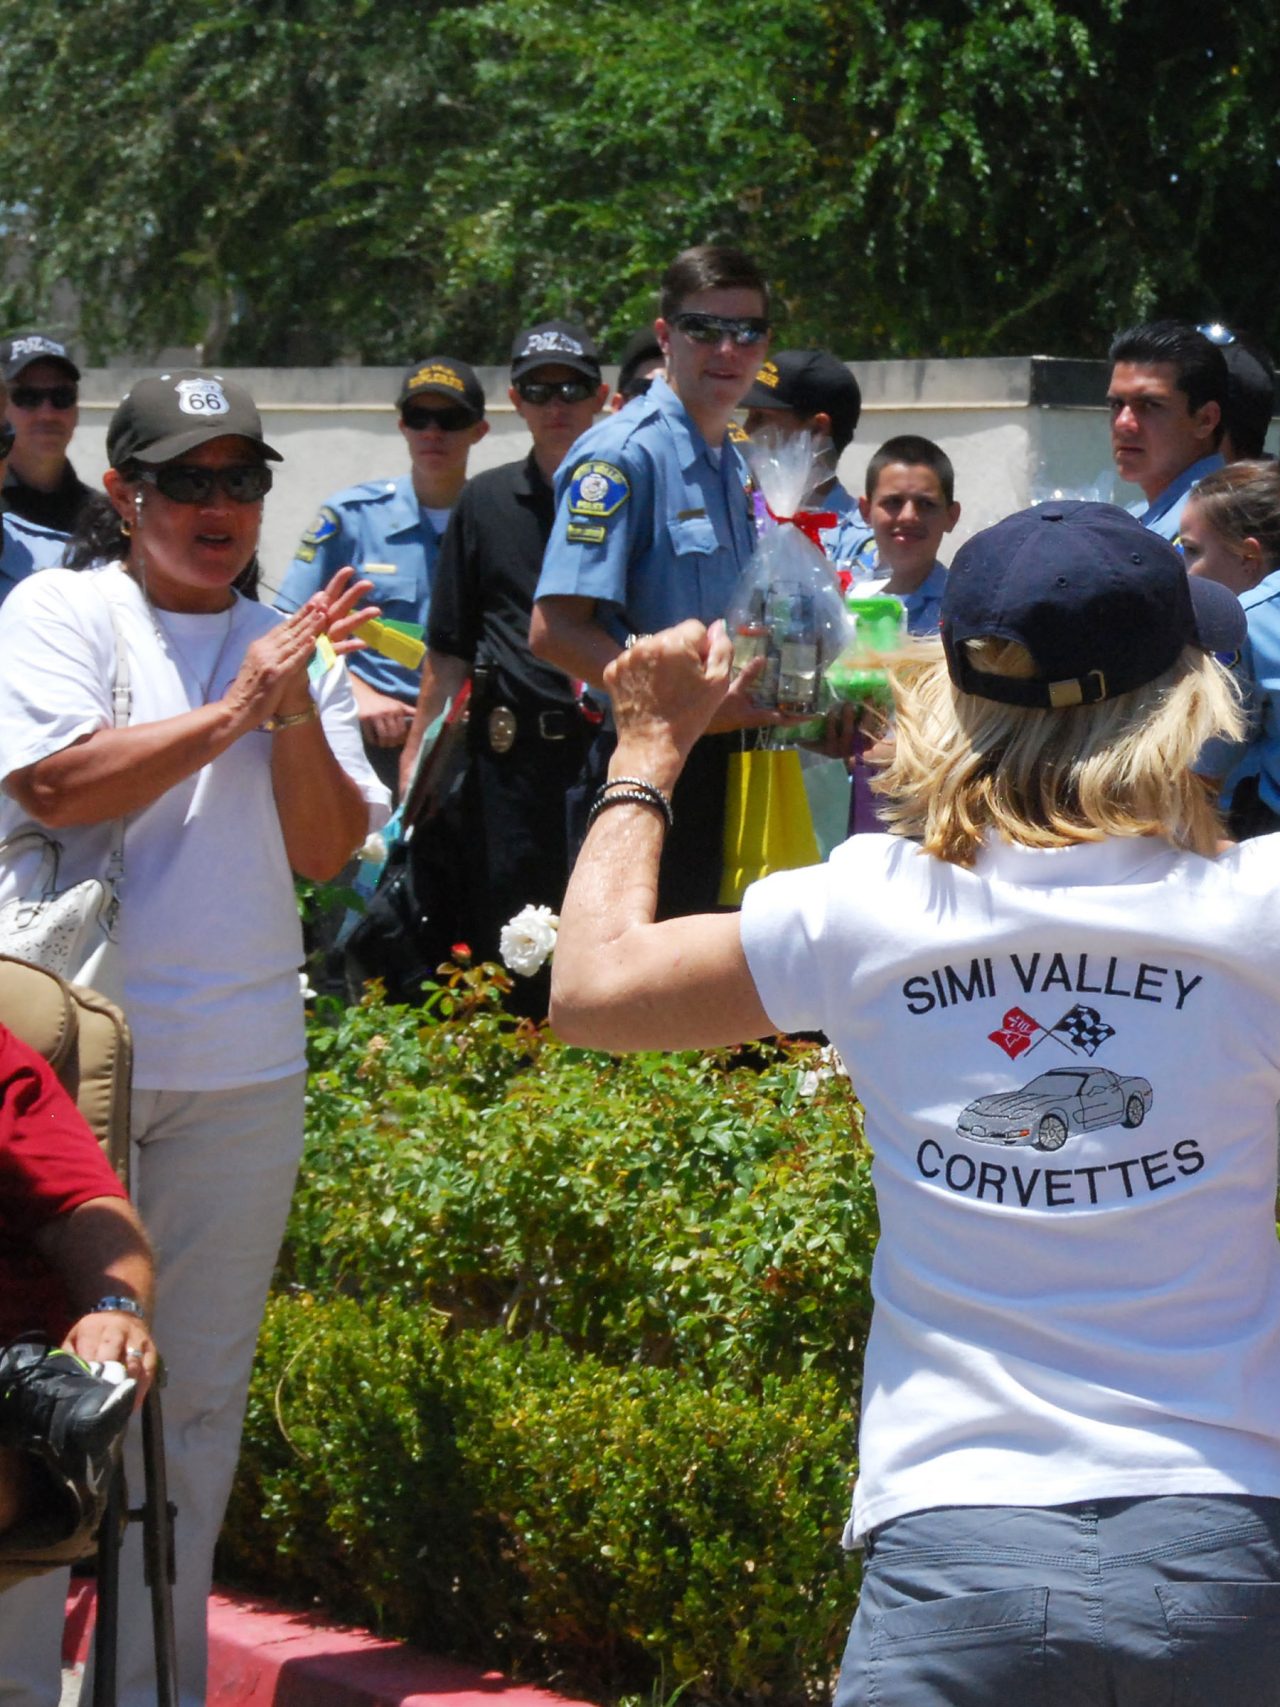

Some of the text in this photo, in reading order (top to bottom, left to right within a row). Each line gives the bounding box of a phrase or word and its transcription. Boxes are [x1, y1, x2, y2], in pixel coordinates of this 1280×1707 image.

[189, 393, 221, 410] 66
[902, 952, 1204, 1015] SIMI VALLEY
[916, 1138, 1206, 1207] CORVETTES
